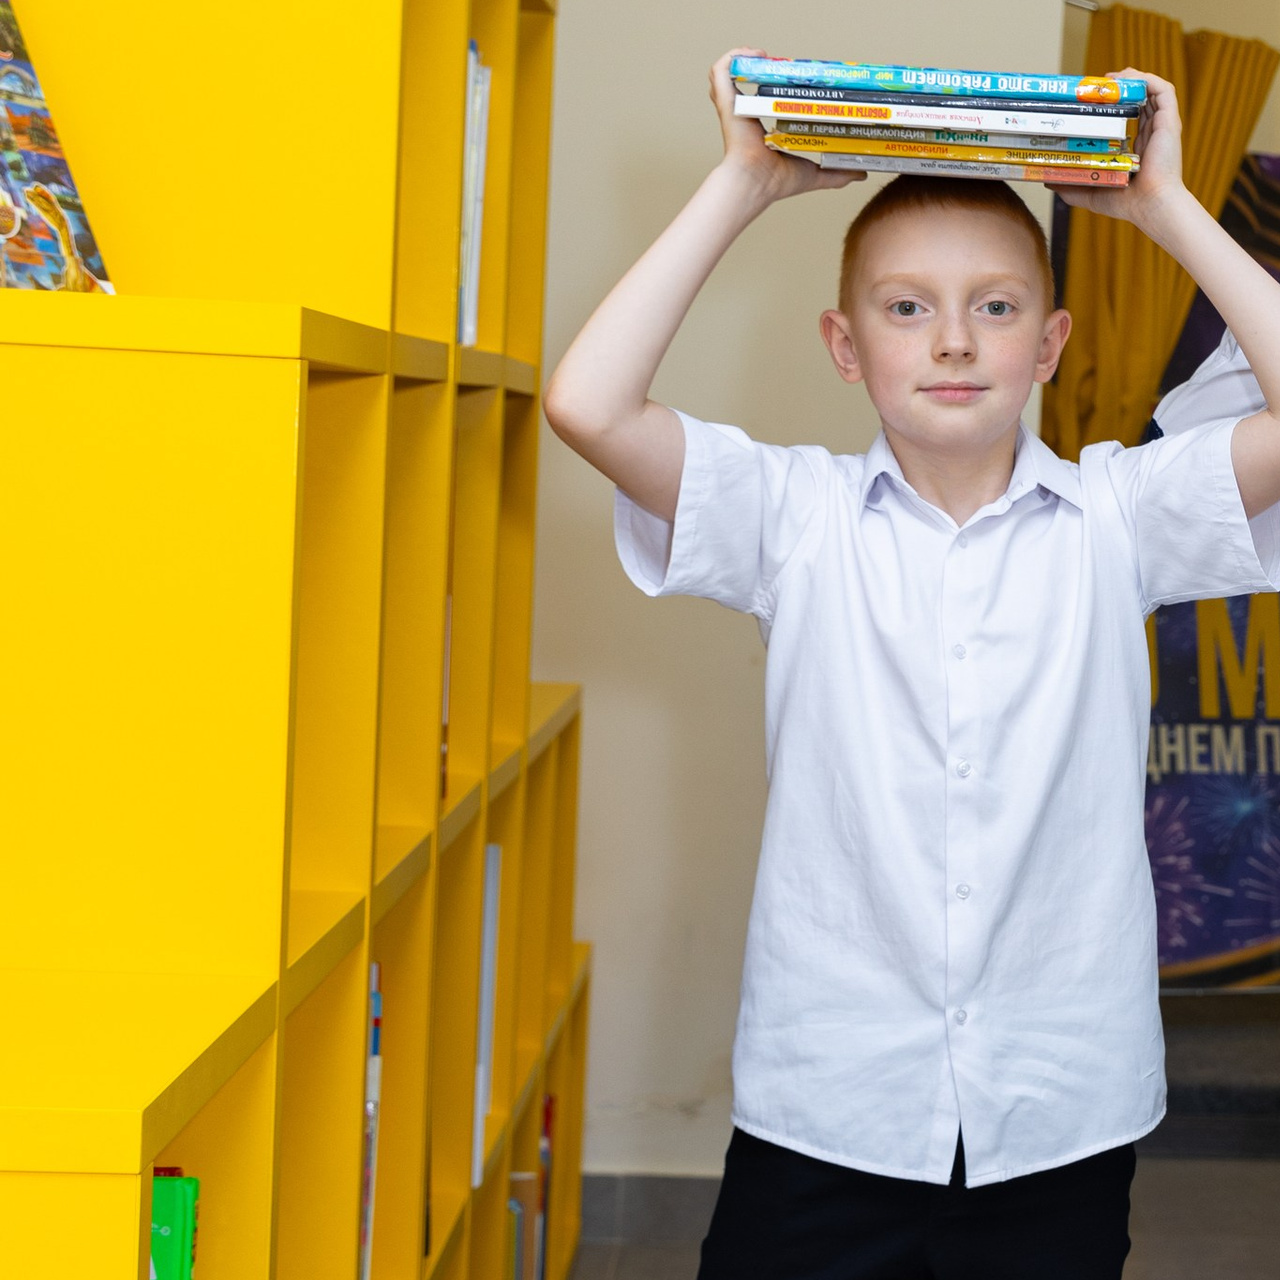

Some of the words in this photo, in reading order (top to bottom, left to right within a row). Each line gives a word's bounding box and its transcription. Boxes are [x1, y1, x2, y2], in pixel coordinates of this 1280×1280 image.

[876, 70, 894, 80] МИР
[902, 70, 991, 89] РАБОТАЕТ
[998, 77, 1033, 93] ЭТО
[1038, 79, 1068, 94] КАК
[772, 87, 845, 99] АВТОМОБИЛИ
[774, 101, 813, 115] МАШИНЫ
[816, 104, 846, 116] УМНЫЕ
[847, 106, 854, 117] И
[856, 106, 889, 119] РОБОТЫ
[788, 124, 809, 133] МОЯ
[812, 125, 847, 135] ПЕРВАЯ
[850, 127, 926, 139] ЭНЦИКЛОПЕДИЯ
[885, 143, 949, 154] АВТОМОБИЛИ
[1005, 150, 1082, 163] ЭНЦИКЛОПЕДИЯ
